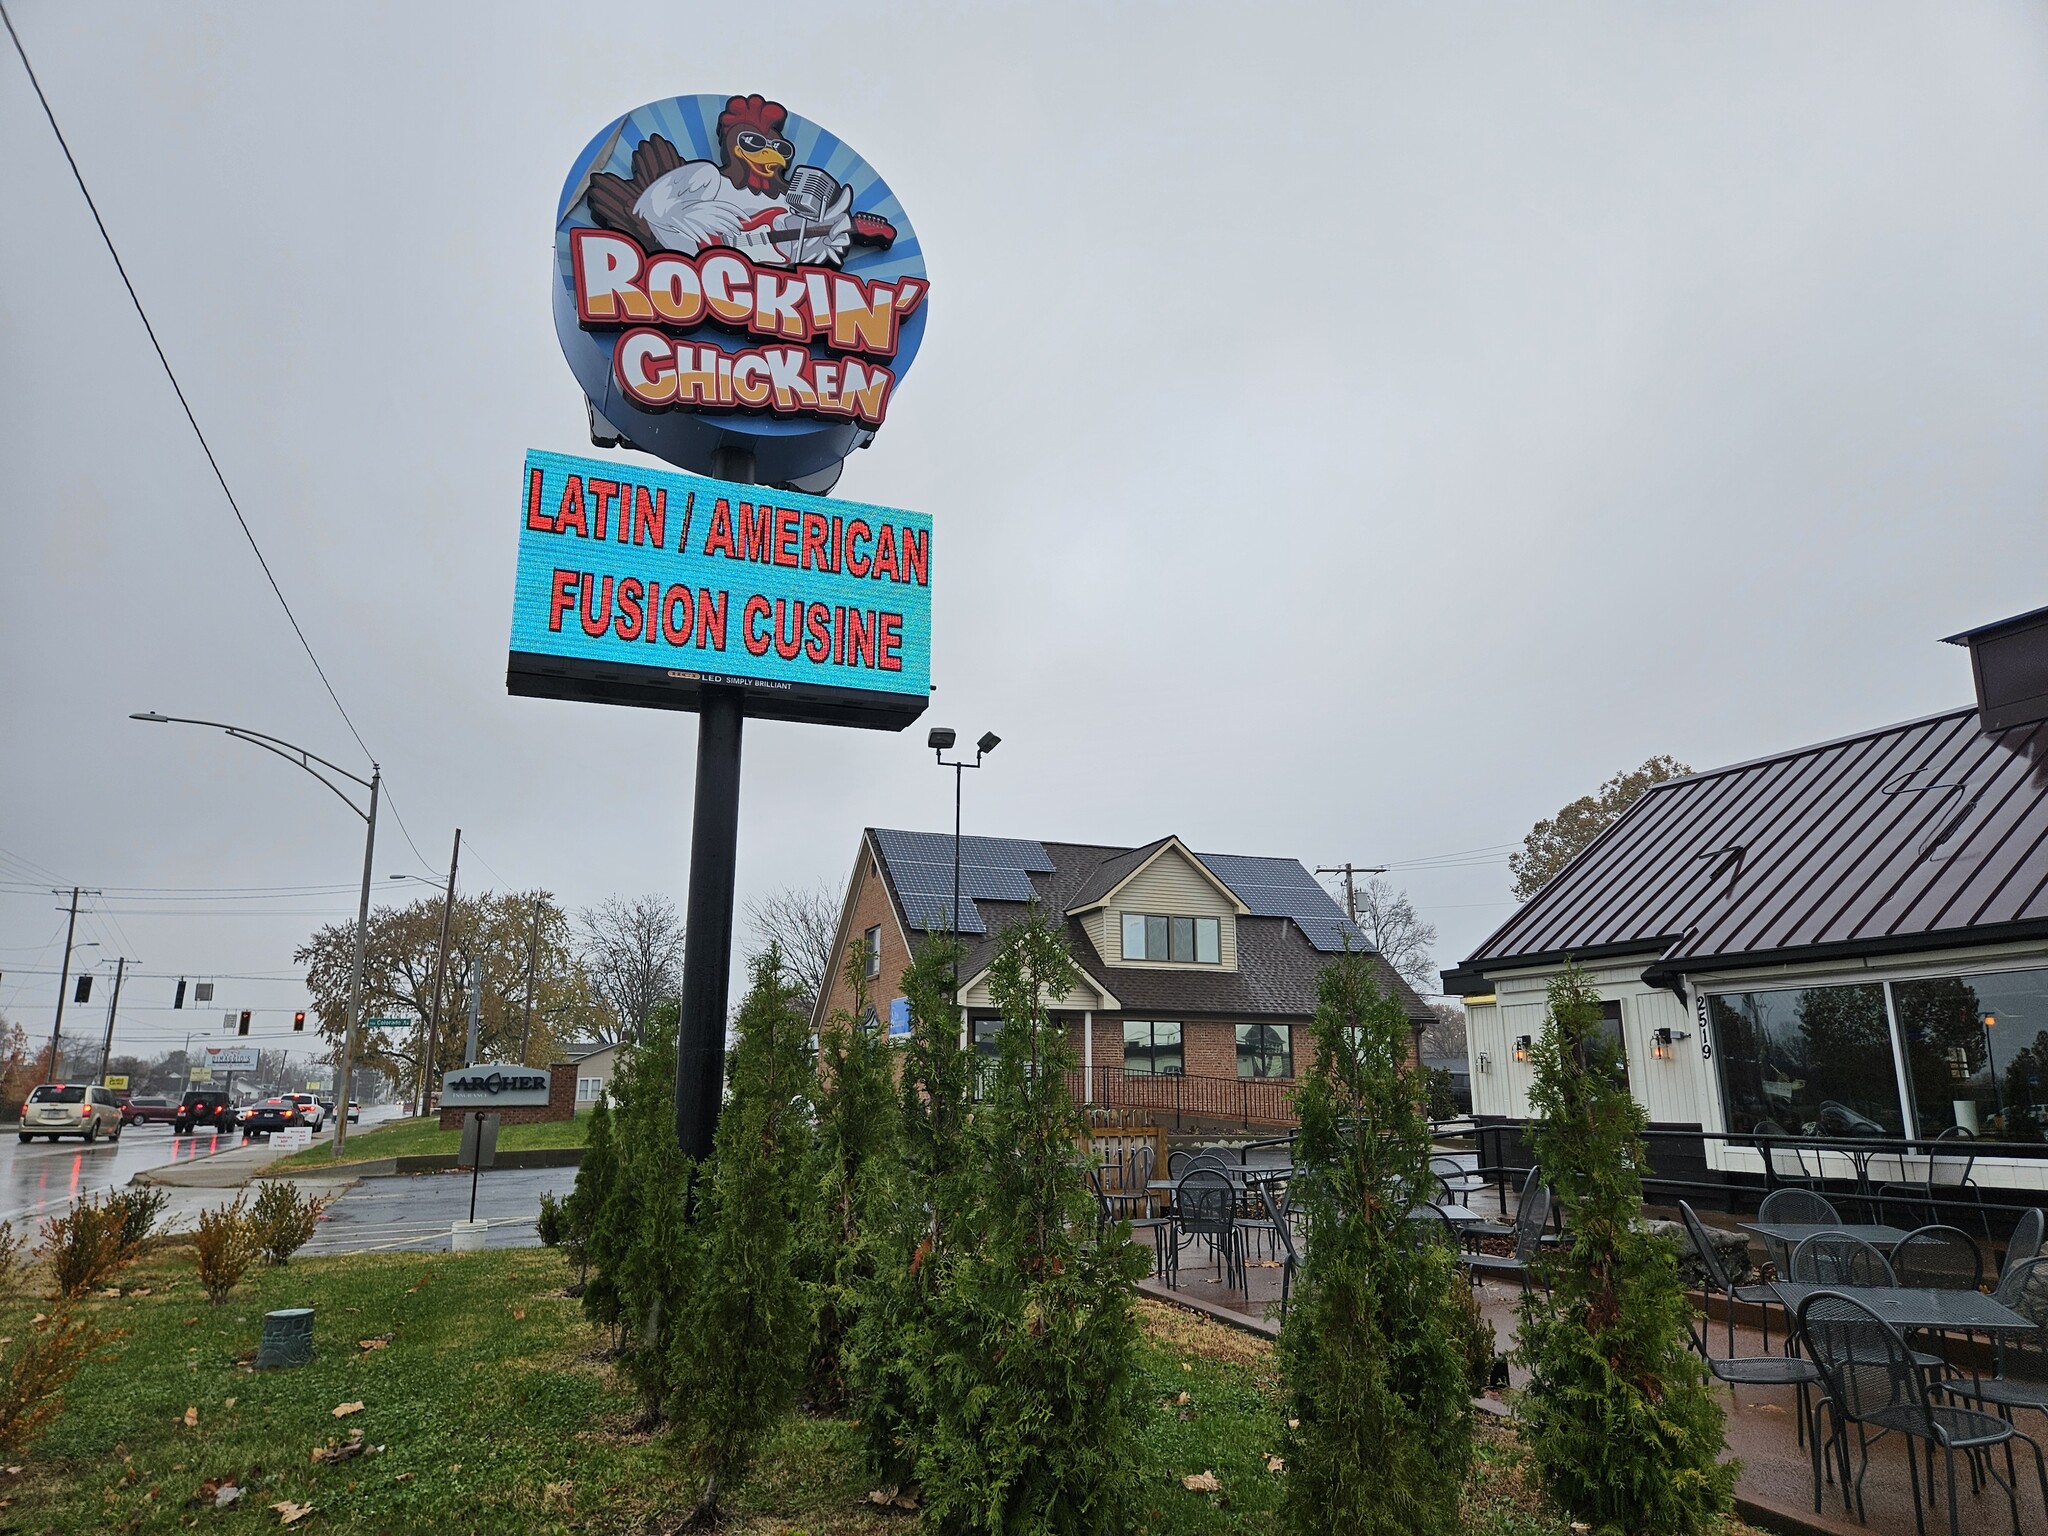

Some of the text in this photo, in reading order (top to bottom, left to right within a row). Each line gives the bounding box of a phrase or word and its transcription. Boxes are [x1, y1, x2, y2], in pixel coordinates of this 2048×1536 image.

[573, 229, 928, 356] ROCKIN'
[616, 328, 893, 423] CHICKEN
[527, 468, 929, 587] LATIN / AMERICAN
[548, 567, 903, 672] FUSION CUSINE
[702, 674, 722, 683] LED
[726, 677, 753, 686] SIMPLY
[754, 680, 792, 690] BRILLIANT
[1697, 996, 1711, 1059] 2519
[450, 1072, 547, 1094] ARCHER
